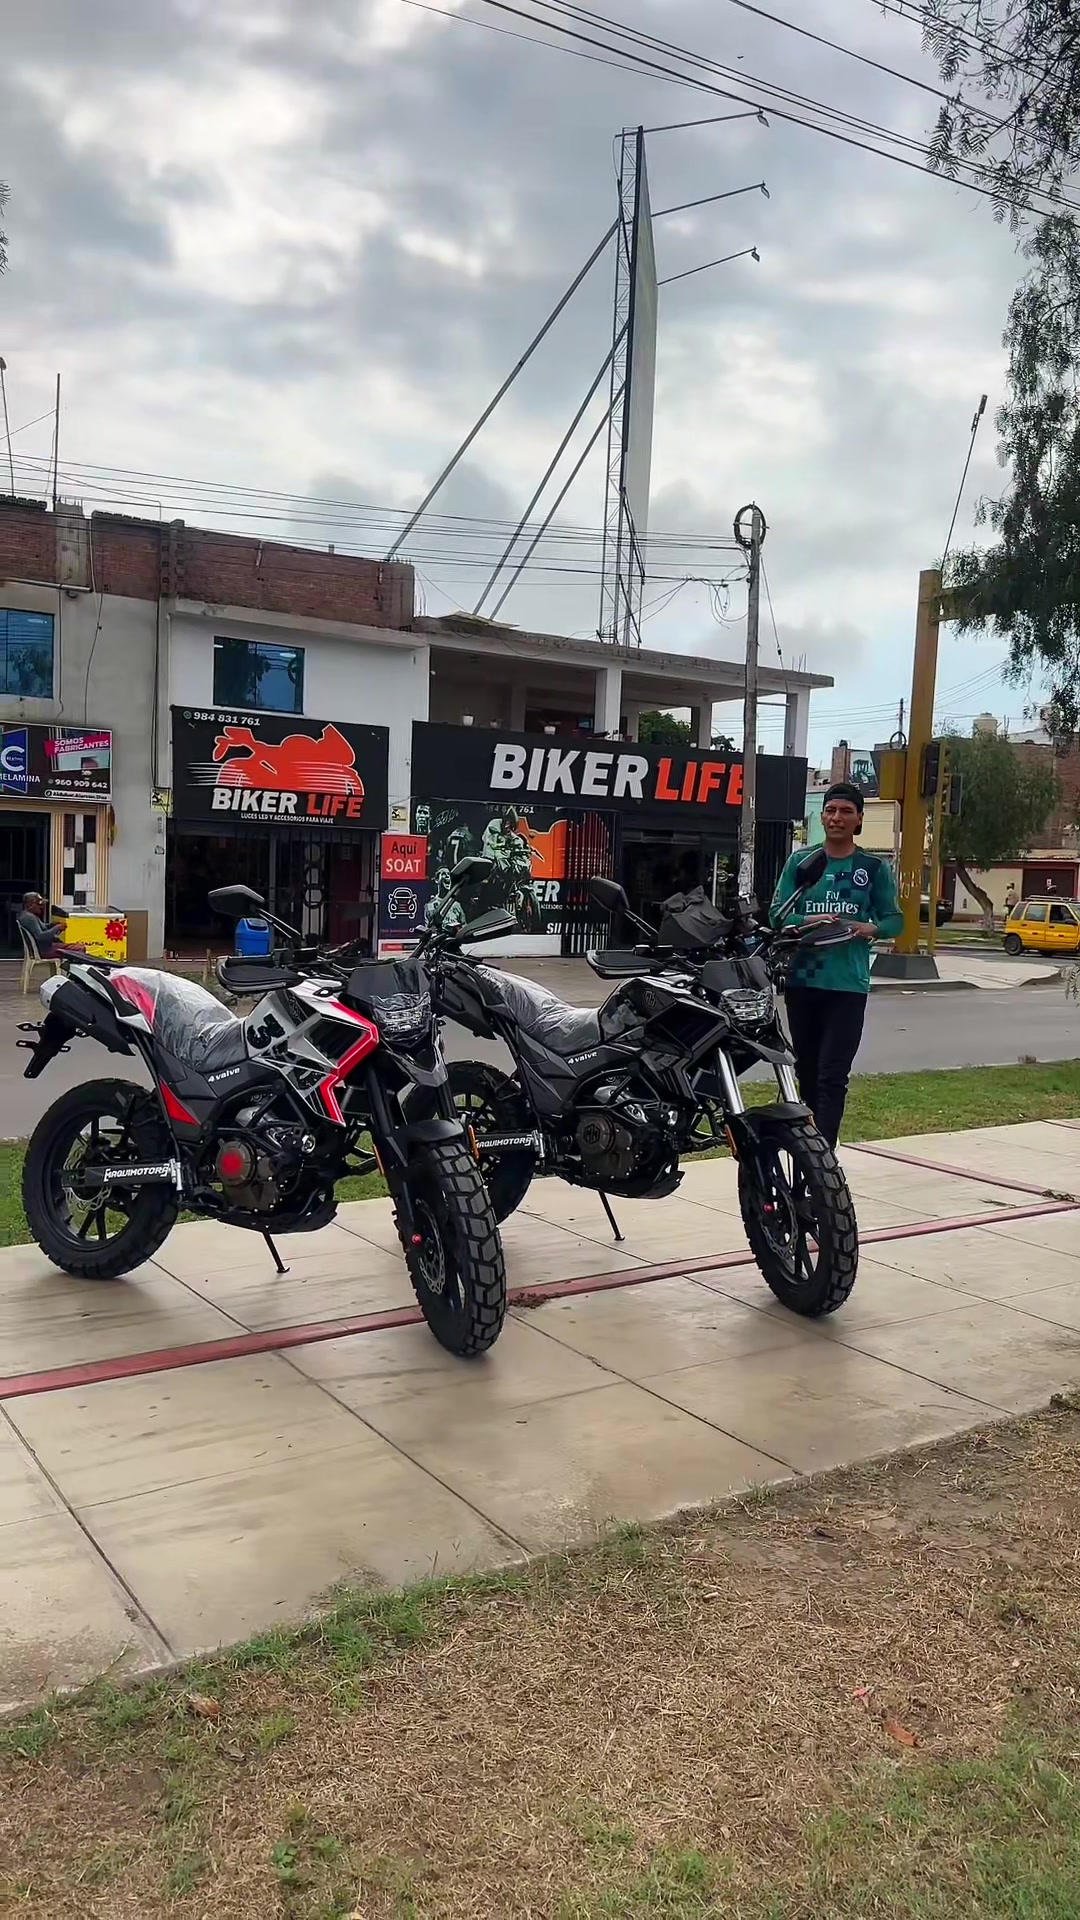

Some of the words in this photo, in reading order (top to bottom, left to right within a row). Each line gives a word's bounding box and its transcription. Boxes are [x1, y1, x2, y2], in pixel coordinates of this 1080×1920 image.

[193, 712, 215, 721] 984
[217, 715, 239, 724] 831
[241, 717, 260, 726] 761
[54, 737, 84, 747] SOMOS
[54, 740, 109, 753] FABRICANTES
[489, 743, 649, 799] BIKER
[654, 757, 744, 805] LIFE
[211, 788, 298, 814] BIKER
[306, 794, 365, 818] LIFE
[519, 805, 535, 814] 761
[274, 814, 305, 822] ACCESORIOS
[386, 858, 421, 873] SOAT
[826, 890, 840, 901] Fly
[805, 900, 859, 915] Emirates
[575, 1051, 598, 1063] valve
[215, 1067, 240, 1080] valve
